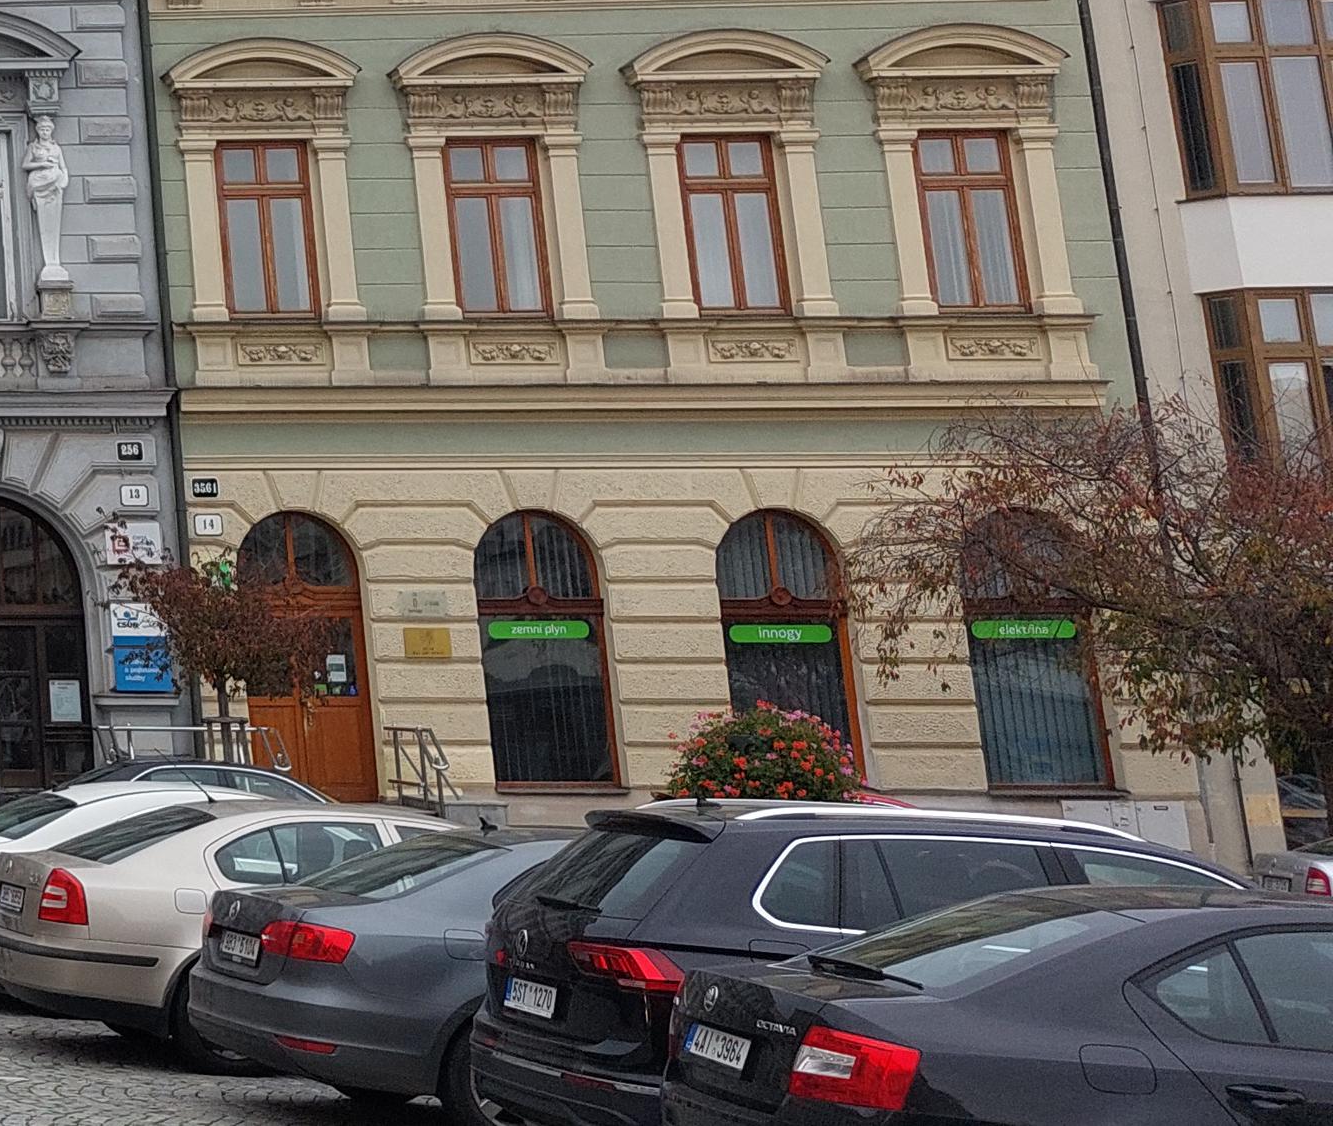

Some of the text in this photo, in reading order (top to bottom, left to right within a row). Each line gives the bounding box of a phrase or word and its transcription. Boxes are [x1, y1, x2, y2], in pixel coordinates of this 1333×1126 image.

[121, 444, 139, 455] 256
[129, 488, 140, 499] 13
[194, 481, 217, 494] 3561
[203, 518, 214, 530] 14
[511, 624, 567, 635] zemní plyn
[758, 626, 802, 641] innogy
[534, 986, 553, 1010] 1270
[756, 1019, 796, 1036] OCTAVIA
[717, 1035, 745, 1065] 3964
